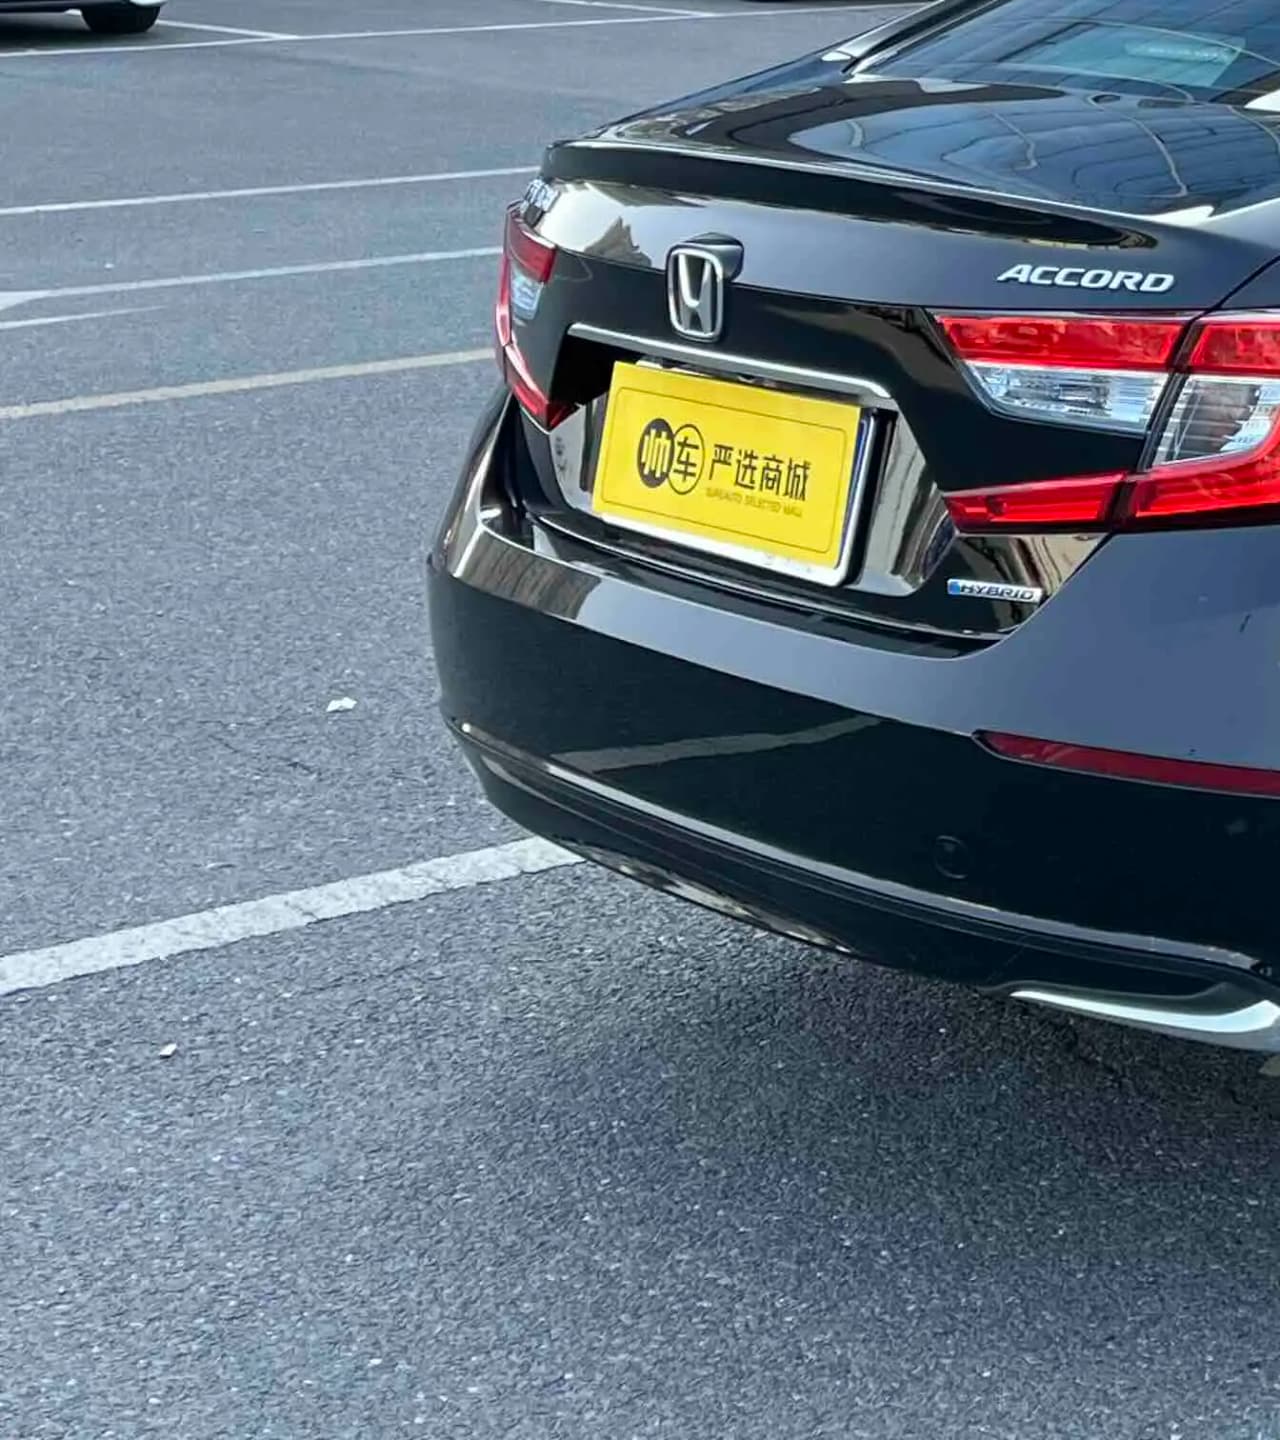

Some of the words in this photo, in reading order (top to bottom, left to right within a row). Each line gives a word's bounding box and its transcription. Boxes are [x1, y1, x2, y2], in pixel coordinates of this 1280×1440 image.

[997, 263, 1176, 293] ACCORD
[708, 443, 812, 502] 严选商城
[959, 584, 1036, 601] HYBRID
